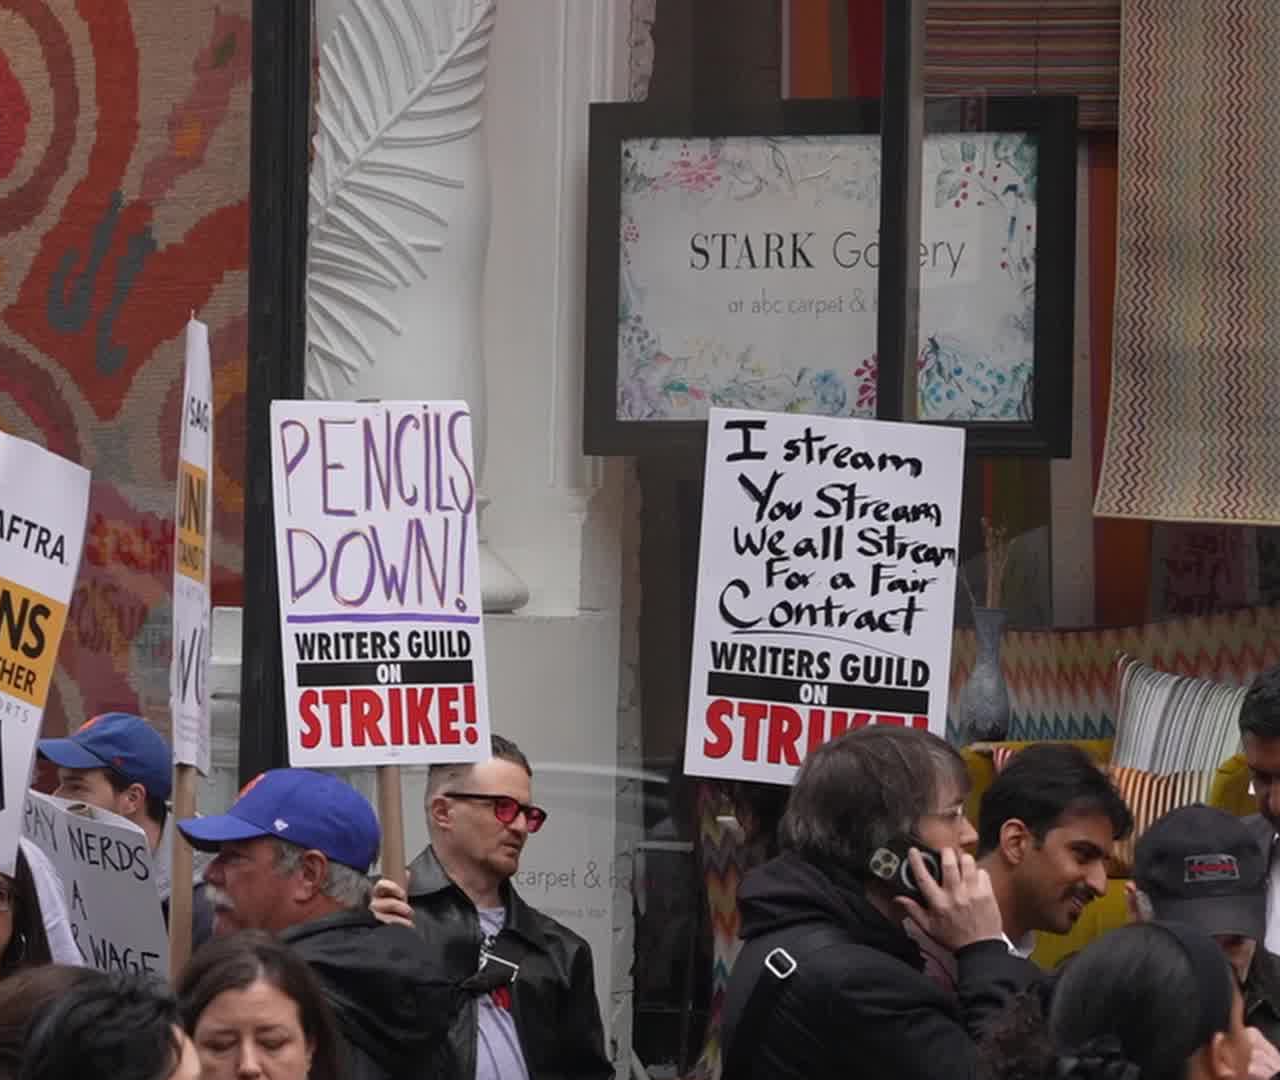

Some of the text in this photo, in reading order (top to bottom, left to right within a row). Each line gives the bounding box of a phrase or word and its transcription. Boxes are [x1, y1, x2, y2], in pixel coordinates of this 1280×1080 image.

[689, 231, 816, 271] STARK
[788, 295, 843, 320] carpet
[724, 419, 923, 477] I stream
[737, 469, 941, 528] You Stream
[733, 525, 785, 557] We
[793, 525, 844, 561] all
[287, 515, 470, 614] DOWN!
[766, 556, 938, 597] For a Fair
[719, 578, 925, 636] Contract
[295, 629, 472, 662] WRITERS GUILD
[710, 640, 930, 689] WRITERS GUILD
[376, 663, 401, 684] ON
[799, 683, 828, 705] ON
[299, 684, 478, 750] STRIKE!
[67, 827, 150, 881] NERDS
[516, 867, 576, 895] carpet
[583, 861, 601, 888] &
